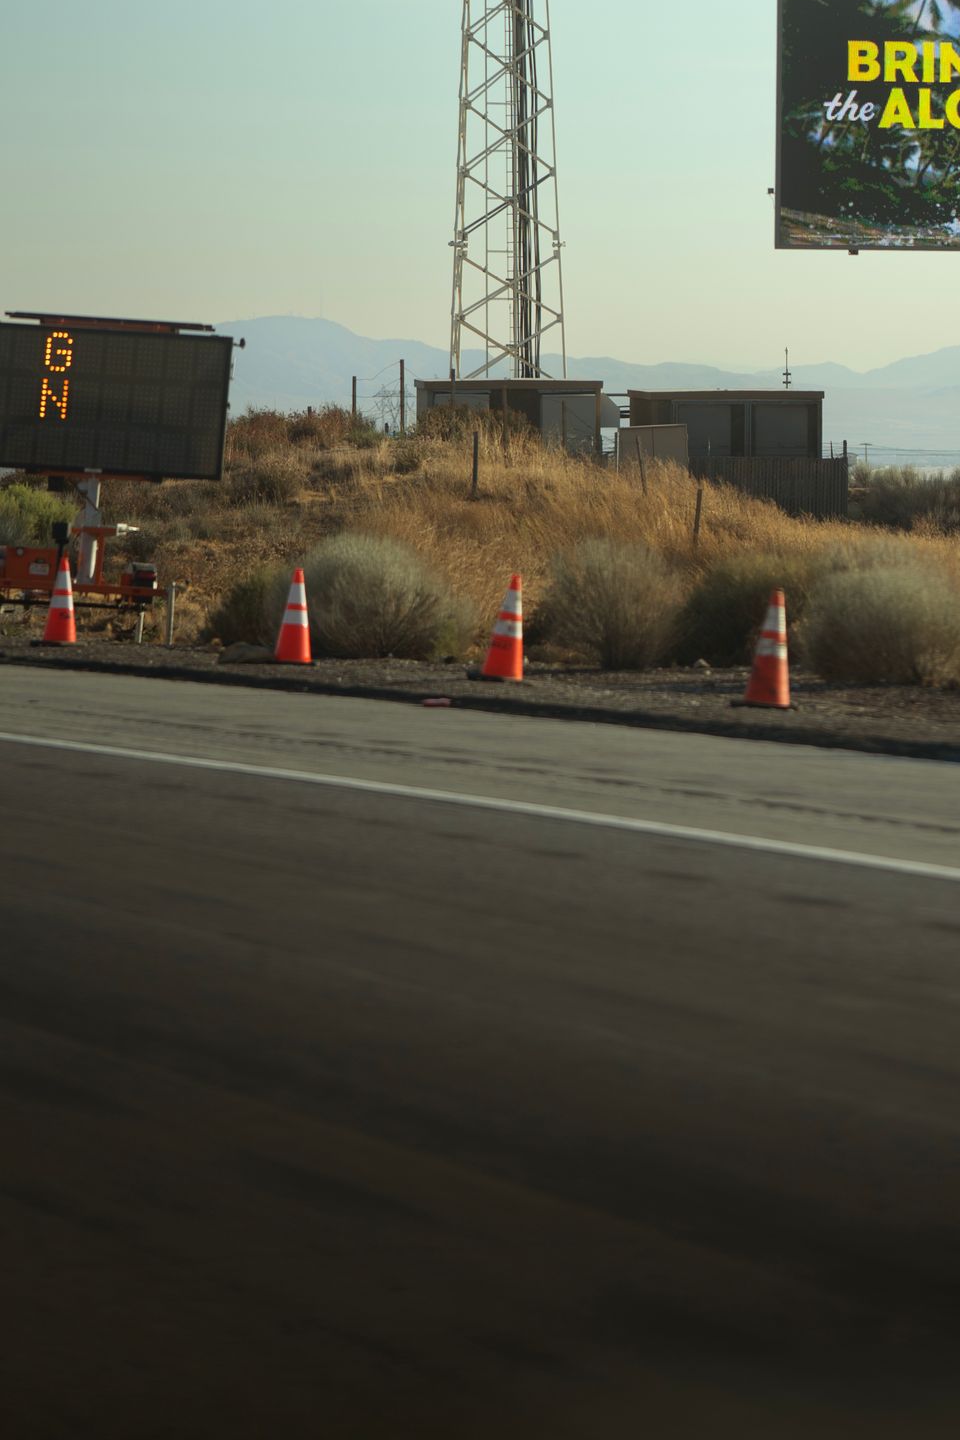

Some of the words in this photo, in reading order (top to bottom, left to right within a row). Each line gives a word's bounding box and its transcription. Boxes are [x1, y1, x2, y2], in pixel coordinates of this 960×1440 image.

[822, 90, 876, 123] the
[45, 331, 73, 372] G
[39, 378, 69, 419] N
